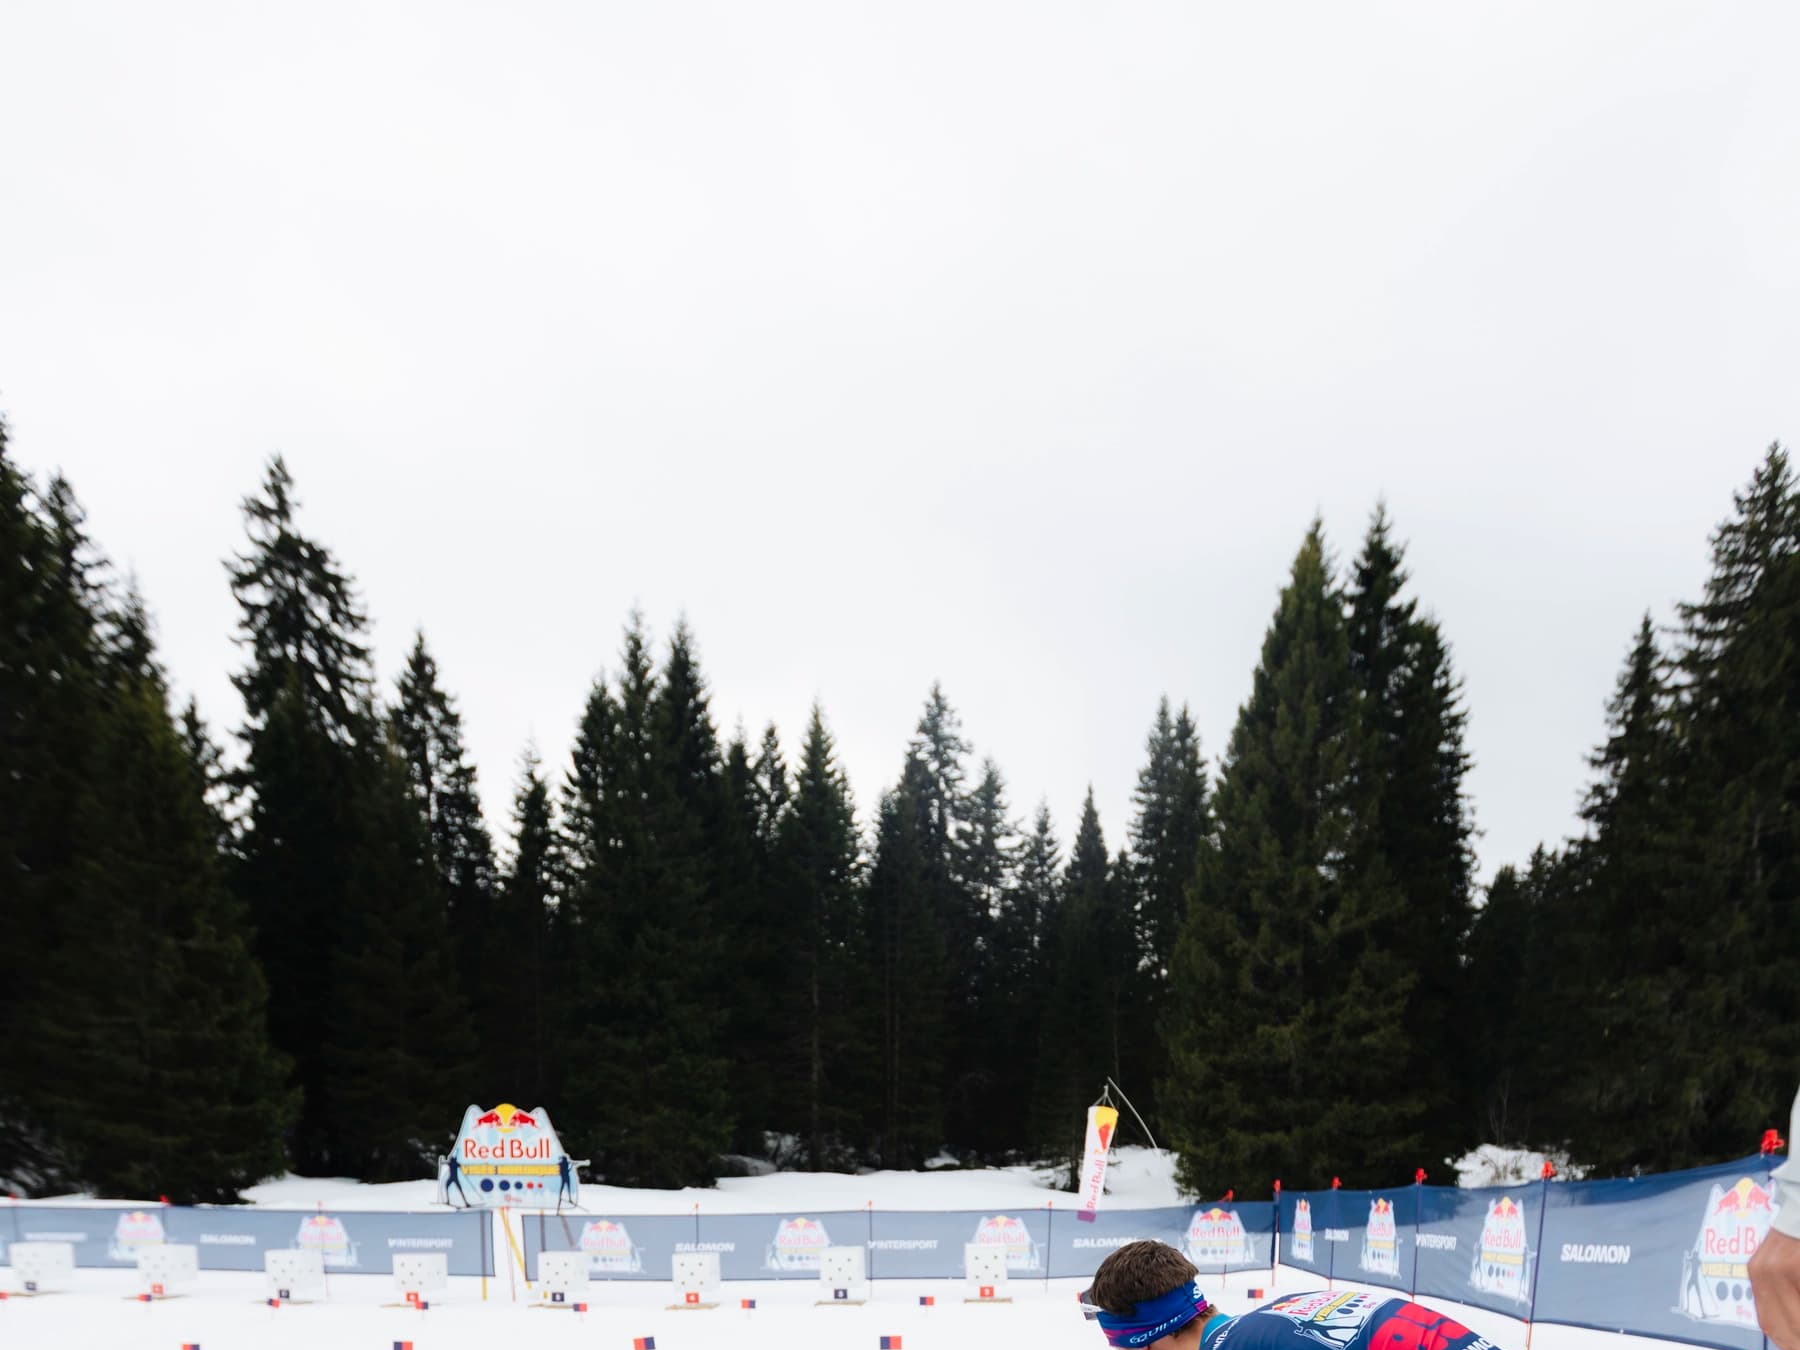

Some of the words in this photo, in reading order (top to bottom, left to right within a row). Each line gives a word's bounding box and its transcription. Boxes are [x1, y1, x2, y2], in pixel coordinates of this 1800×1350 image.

[463, 1138, 505, 1159] Red
[509, 1137, 550, 1159] Bull
[1086, 1182, 1098, 1210] Red
[1092, 1159, 1106, 1184] Bull
[1192, 1226, 1216, 1238] Red
[1219, 1226, 1240, 1238] Bull
[1485, 1229, 1502, 1246] Red
[1503, 1229, 1522, 1248] Bull
[1704, 1225, 1740, 1255] Red
[674, 1242, 735, 1252] SALOMON
[867, 1239, 938, 1250] WINTERSPORT
[1560, 1243, 1631, 1264] SALOMON
